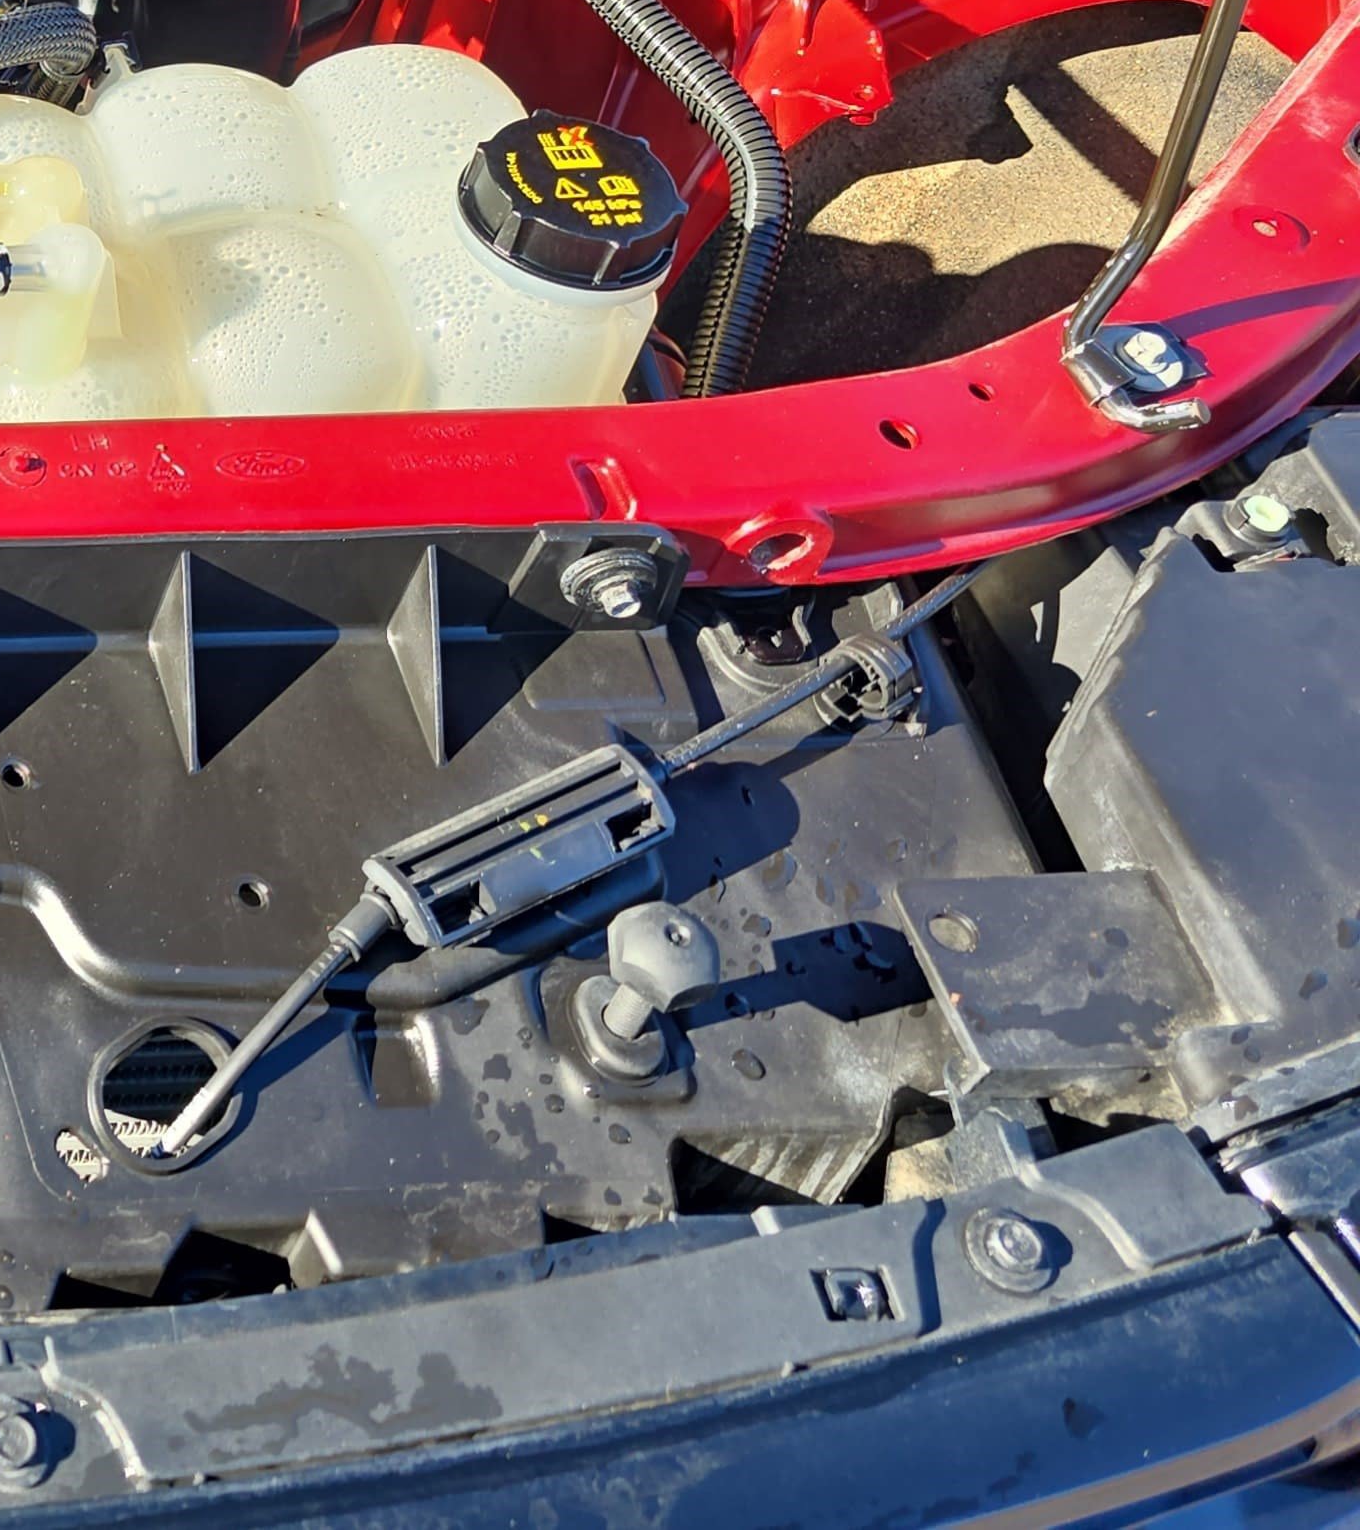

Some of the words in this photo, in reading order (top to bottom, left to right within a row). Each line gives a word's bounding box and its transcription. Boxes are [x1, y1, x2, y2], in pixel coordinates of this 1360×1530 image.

[572, 200, 605, 212] 145
[588, 213, 612, 226] 21
[614, 212, 642, 226] psi
